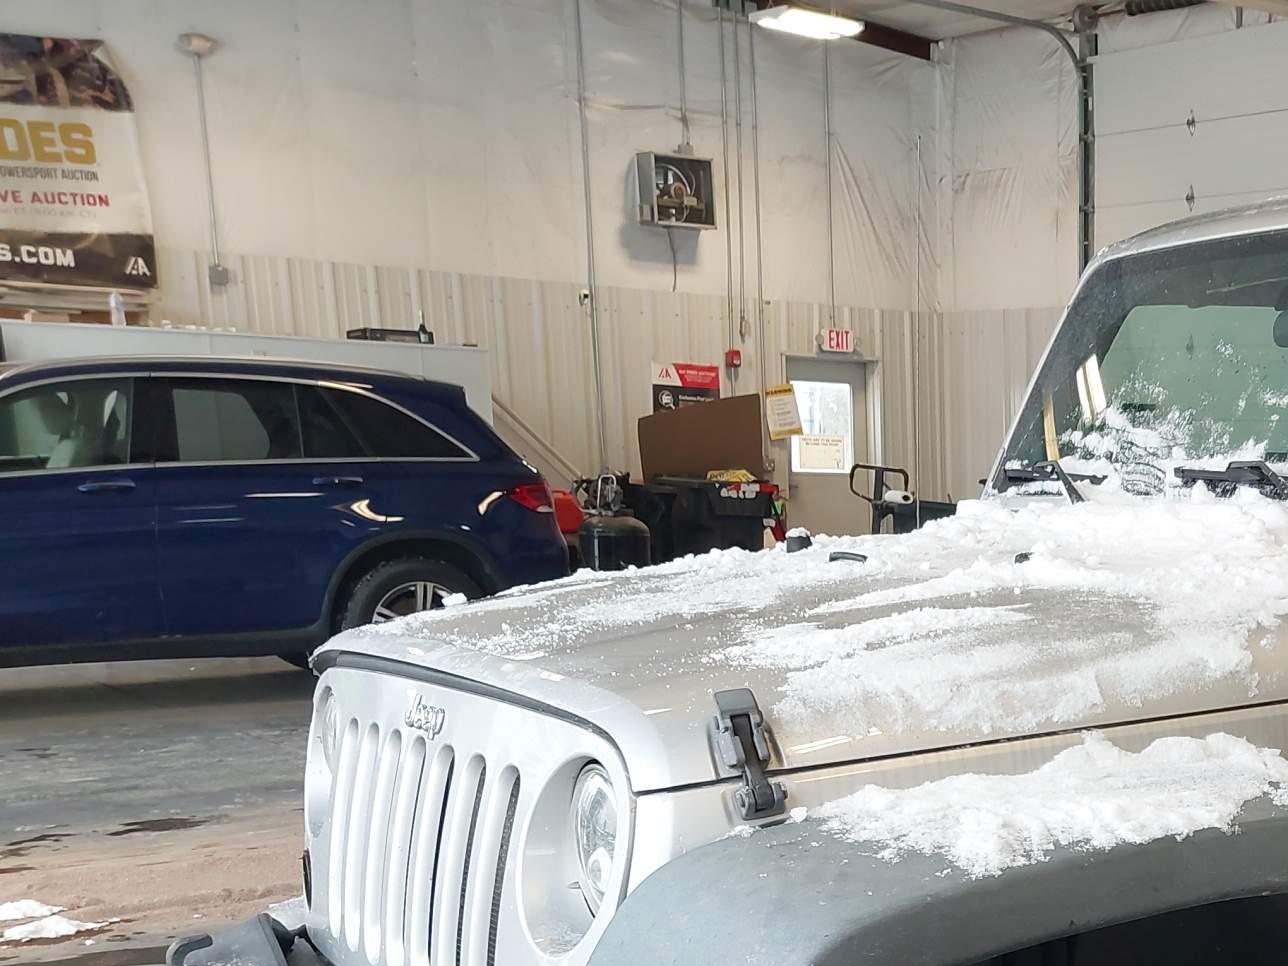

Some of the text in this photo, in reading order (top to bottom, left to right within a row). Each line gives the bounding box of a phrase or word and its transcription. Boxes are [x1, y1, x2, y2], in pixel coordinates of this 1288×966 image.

[61, 169, 99, 182] AUCTION
[31, 191, 110, 207] AUCTION
[0, 243, 75, 267] S.COM
[828, 329, 850, 350] EXIT
[405, 693, 446, 741] Jeep
